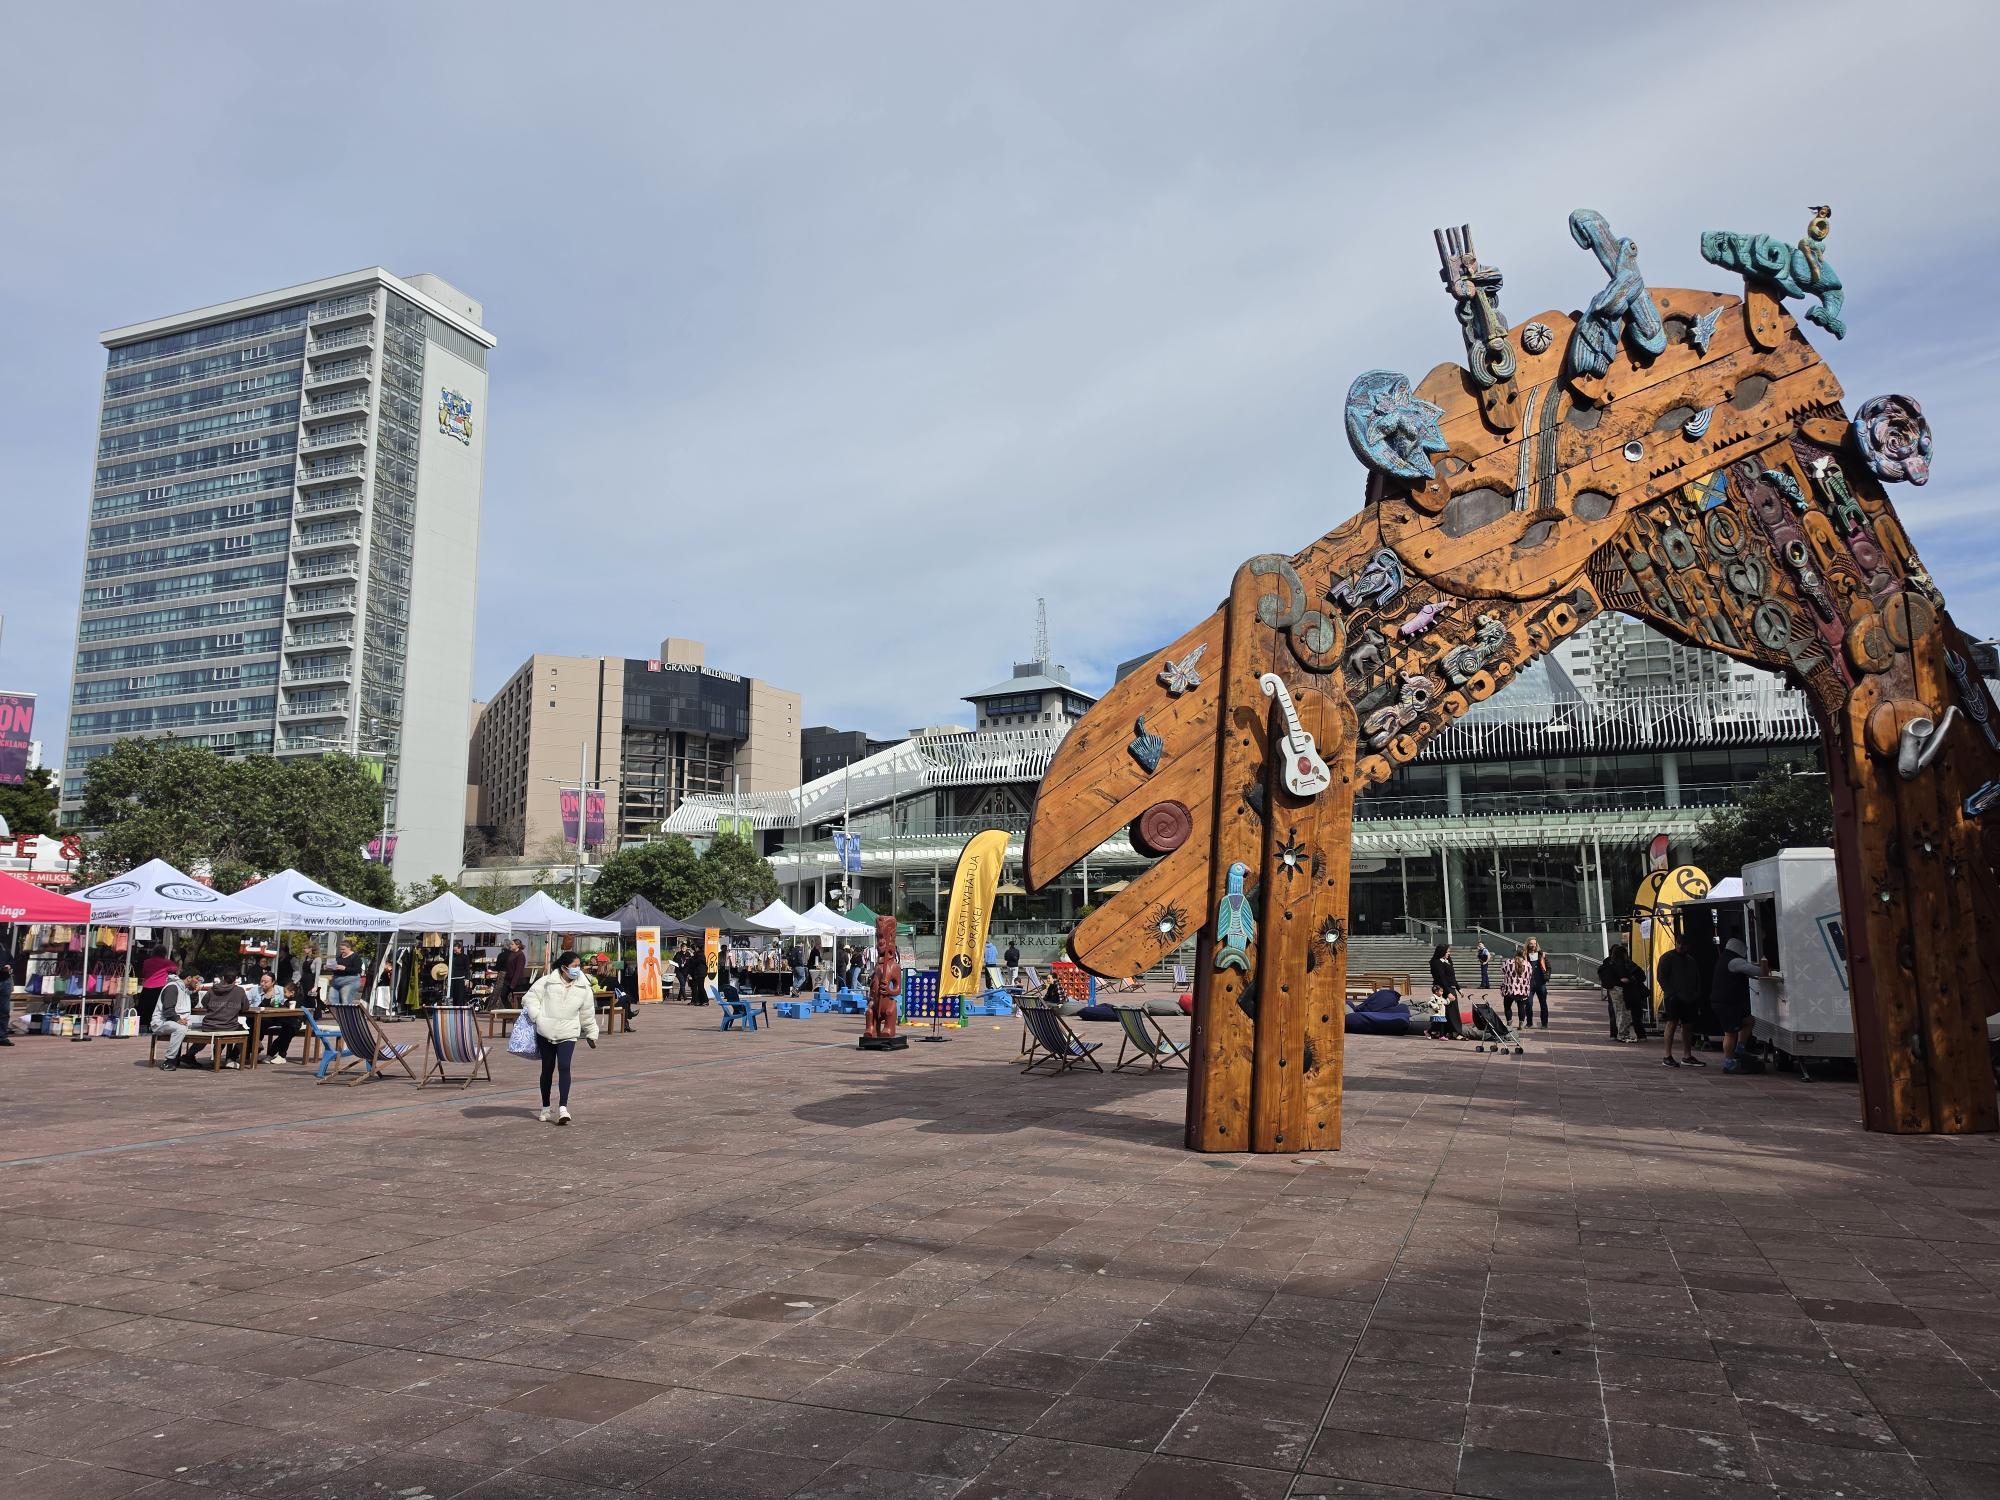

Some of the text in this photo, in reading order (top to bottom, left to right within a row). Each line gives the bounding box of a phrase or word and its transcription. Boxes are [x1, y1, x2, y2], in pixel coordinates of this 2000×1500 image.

[664, 662, 697, 673] GRAND
[700, 666, 741, 683] MILLENNIUM
[0, 696, 18, 705] T'S
[0, 704, 33, 733] ON
[0, 740, 28, 749] CKLAND
[561, 796, 579, 812] ON
[587, 797, 605, 814] ON
[59, 835, 81, 860] &
[0, 905, 26, 918] ingo
[164, 912, 266, 924] Five O'Clock Somewhere
[303, 916, 391, 928] www.fosclothing.online
[1002, 936, 1057, 946] TERRACE
